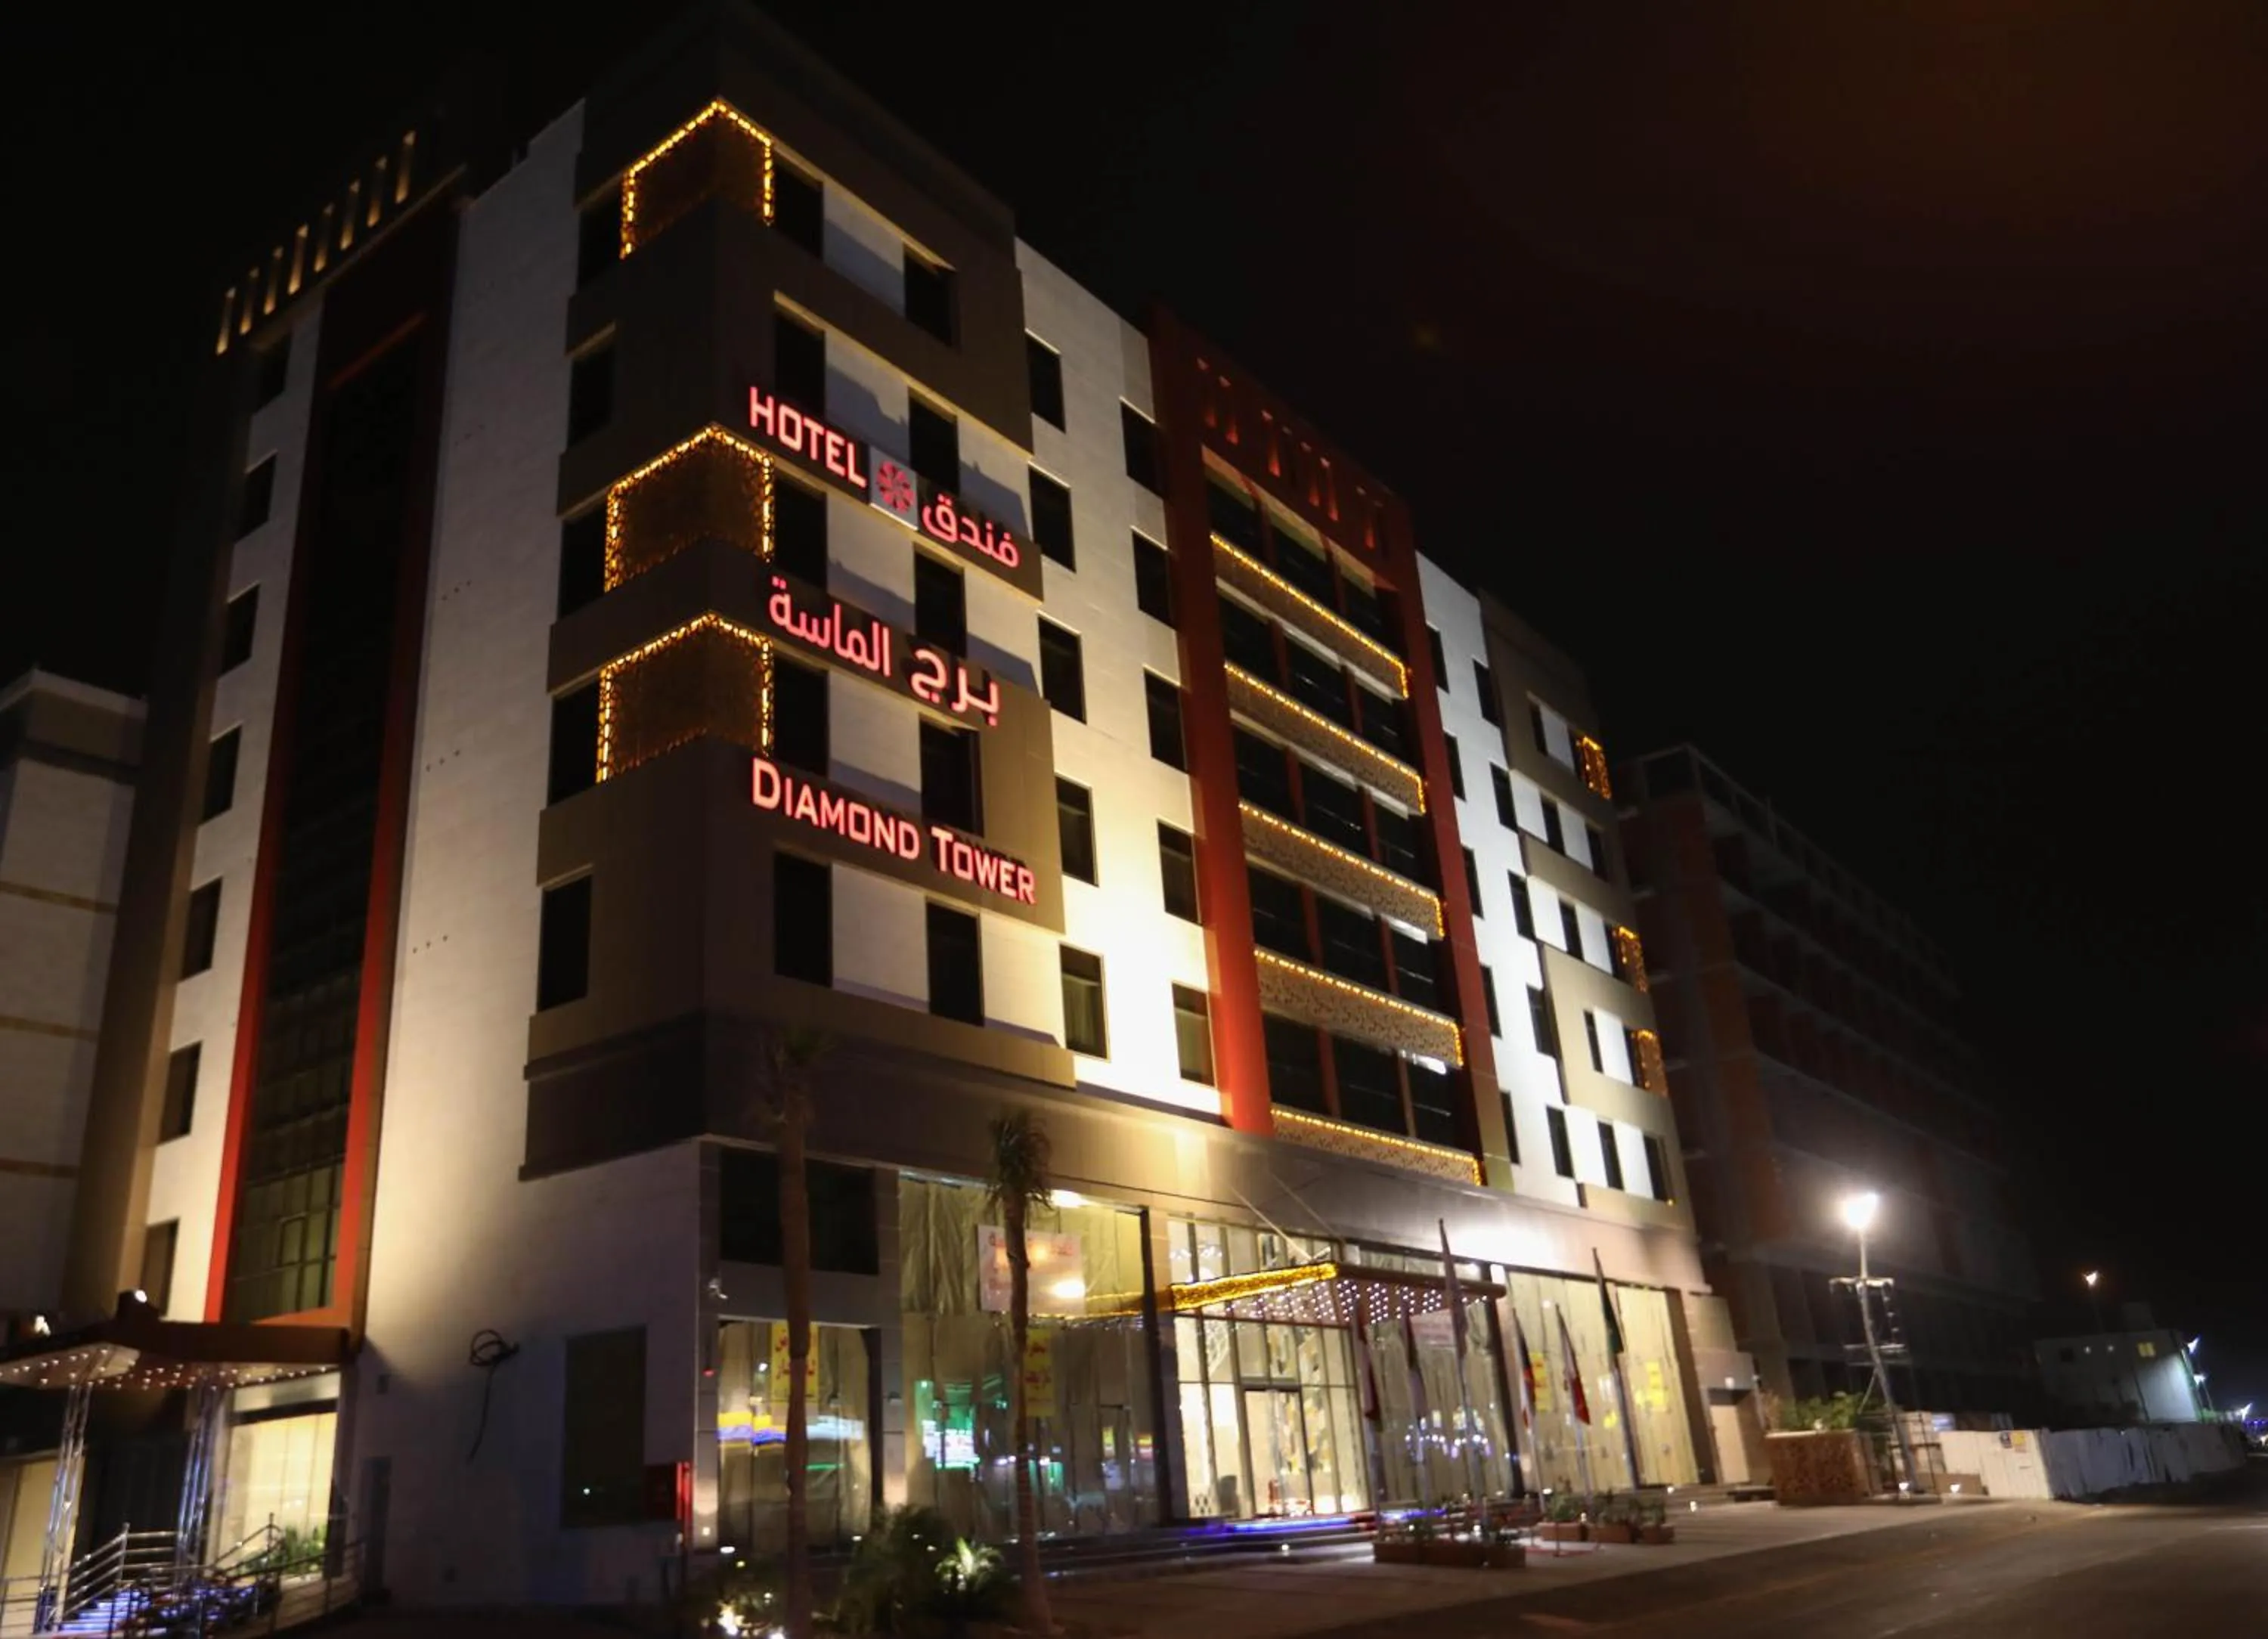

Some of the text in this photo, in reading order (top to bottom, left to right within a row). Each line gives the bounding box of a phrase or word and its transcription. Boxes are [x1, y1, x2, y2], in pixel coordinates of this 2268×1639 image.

[749, 386, 868, 488] HOTEL
[922, 493, 1020, 569] فندق
[769, 575, 1000, 727] برج الماسة
[751, 758, 1036, 904] DIAMOND TOWER
